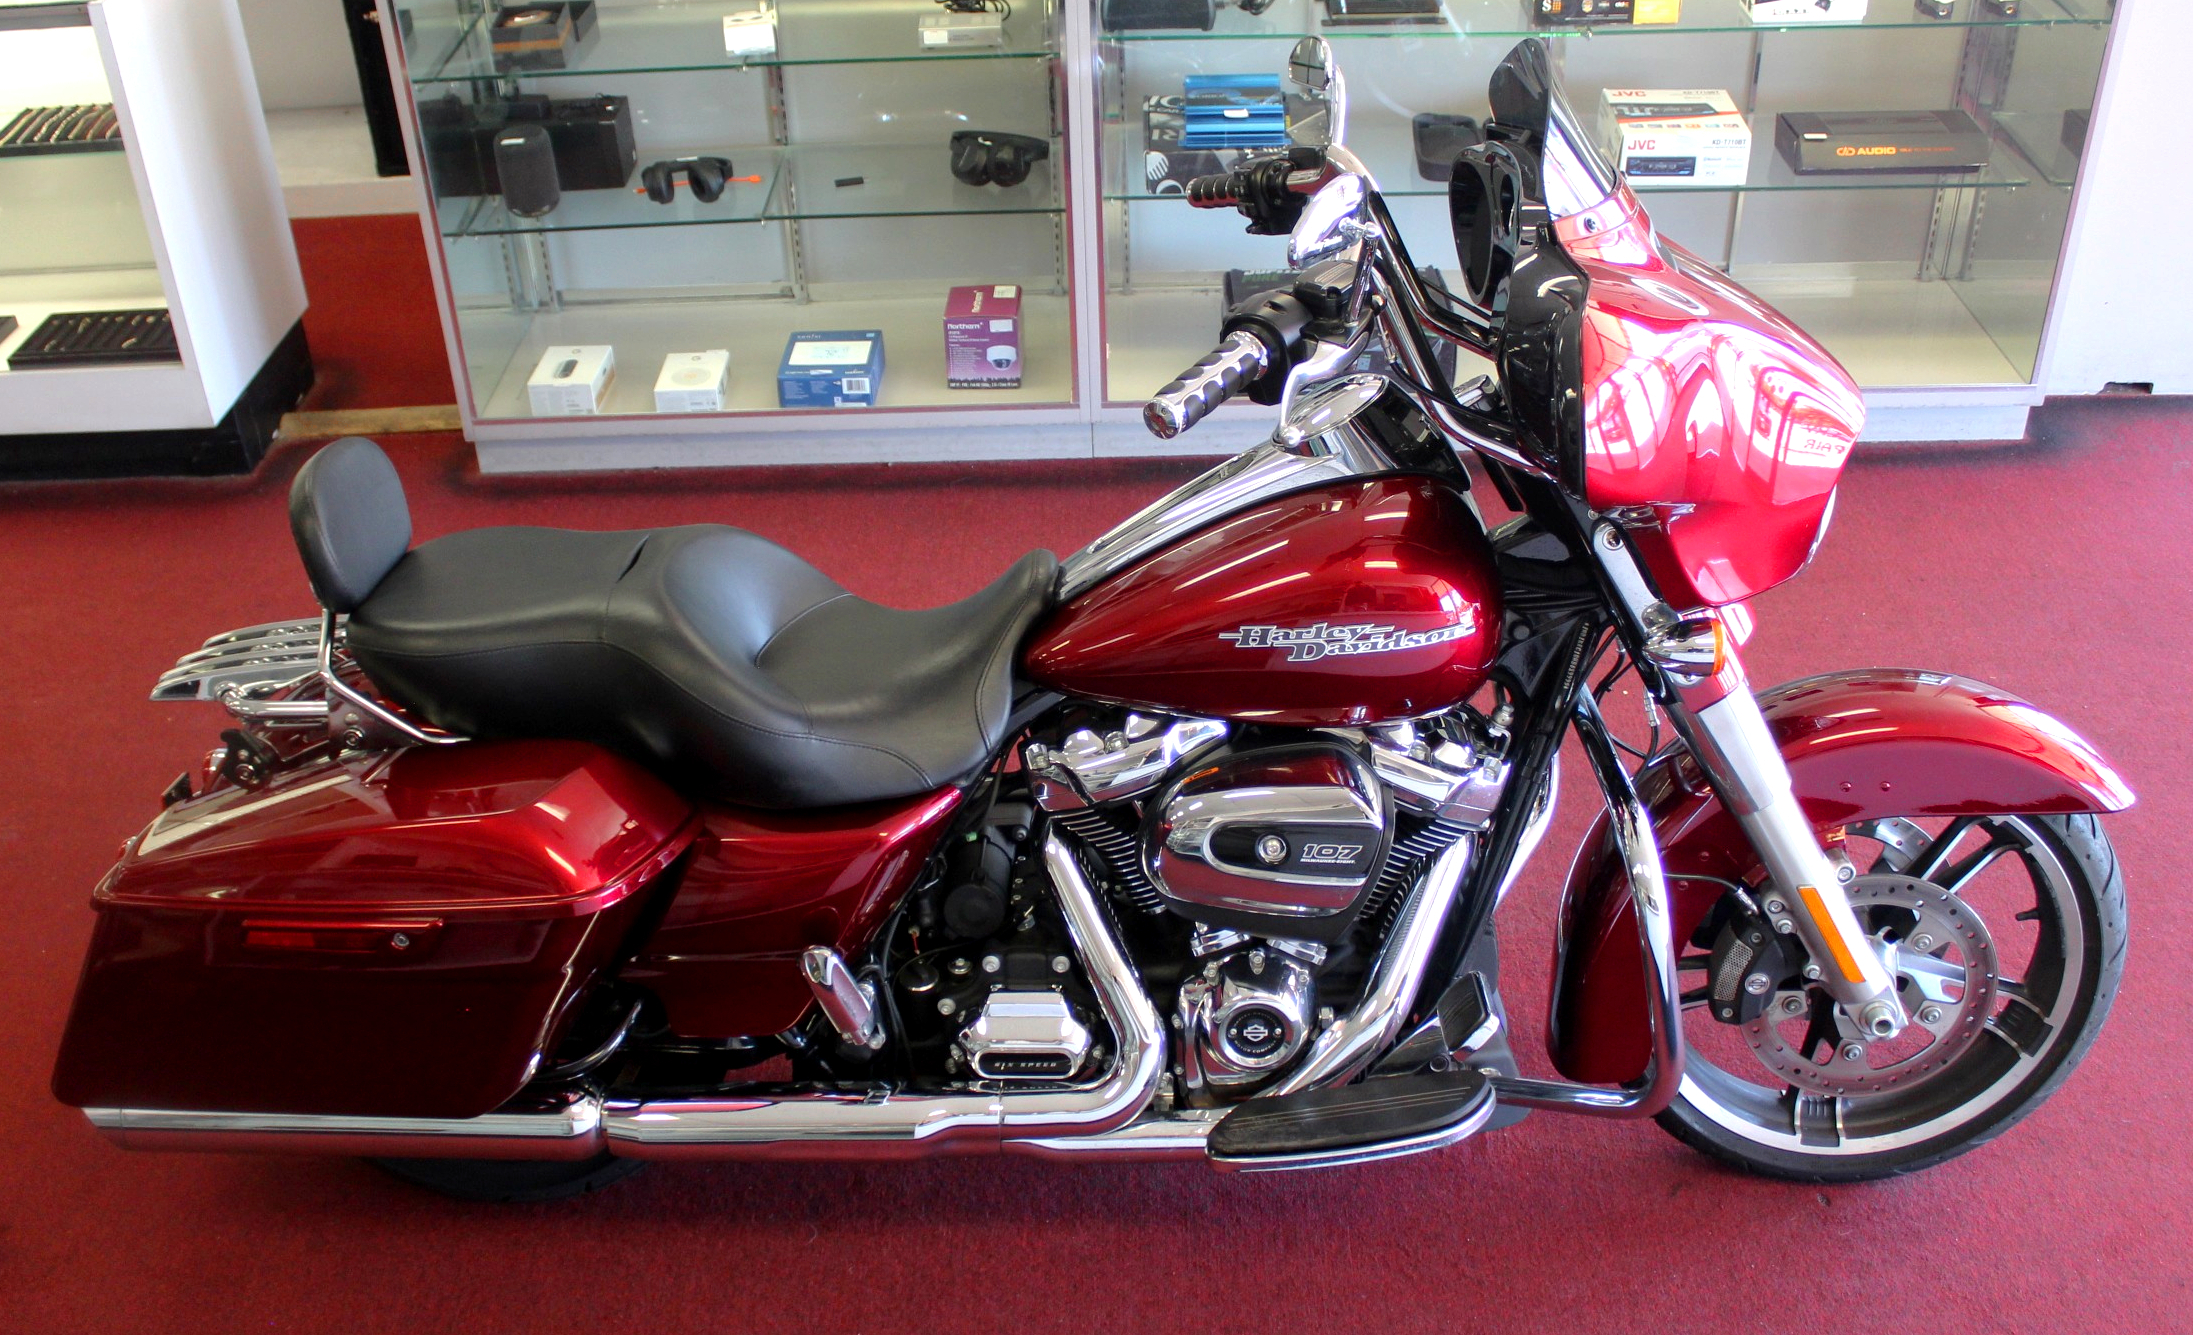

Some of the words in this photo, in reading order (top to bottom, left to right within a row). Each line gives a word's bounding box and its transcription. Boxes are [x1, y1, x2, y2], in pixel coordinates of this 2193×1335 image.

[1628, 139, 1656, 150] JVC
[1857, 146, 1897, 155] AUDIO
[1273, 623, 1477, 662] Davidson
[1302, 843, 1363, 859] 107
